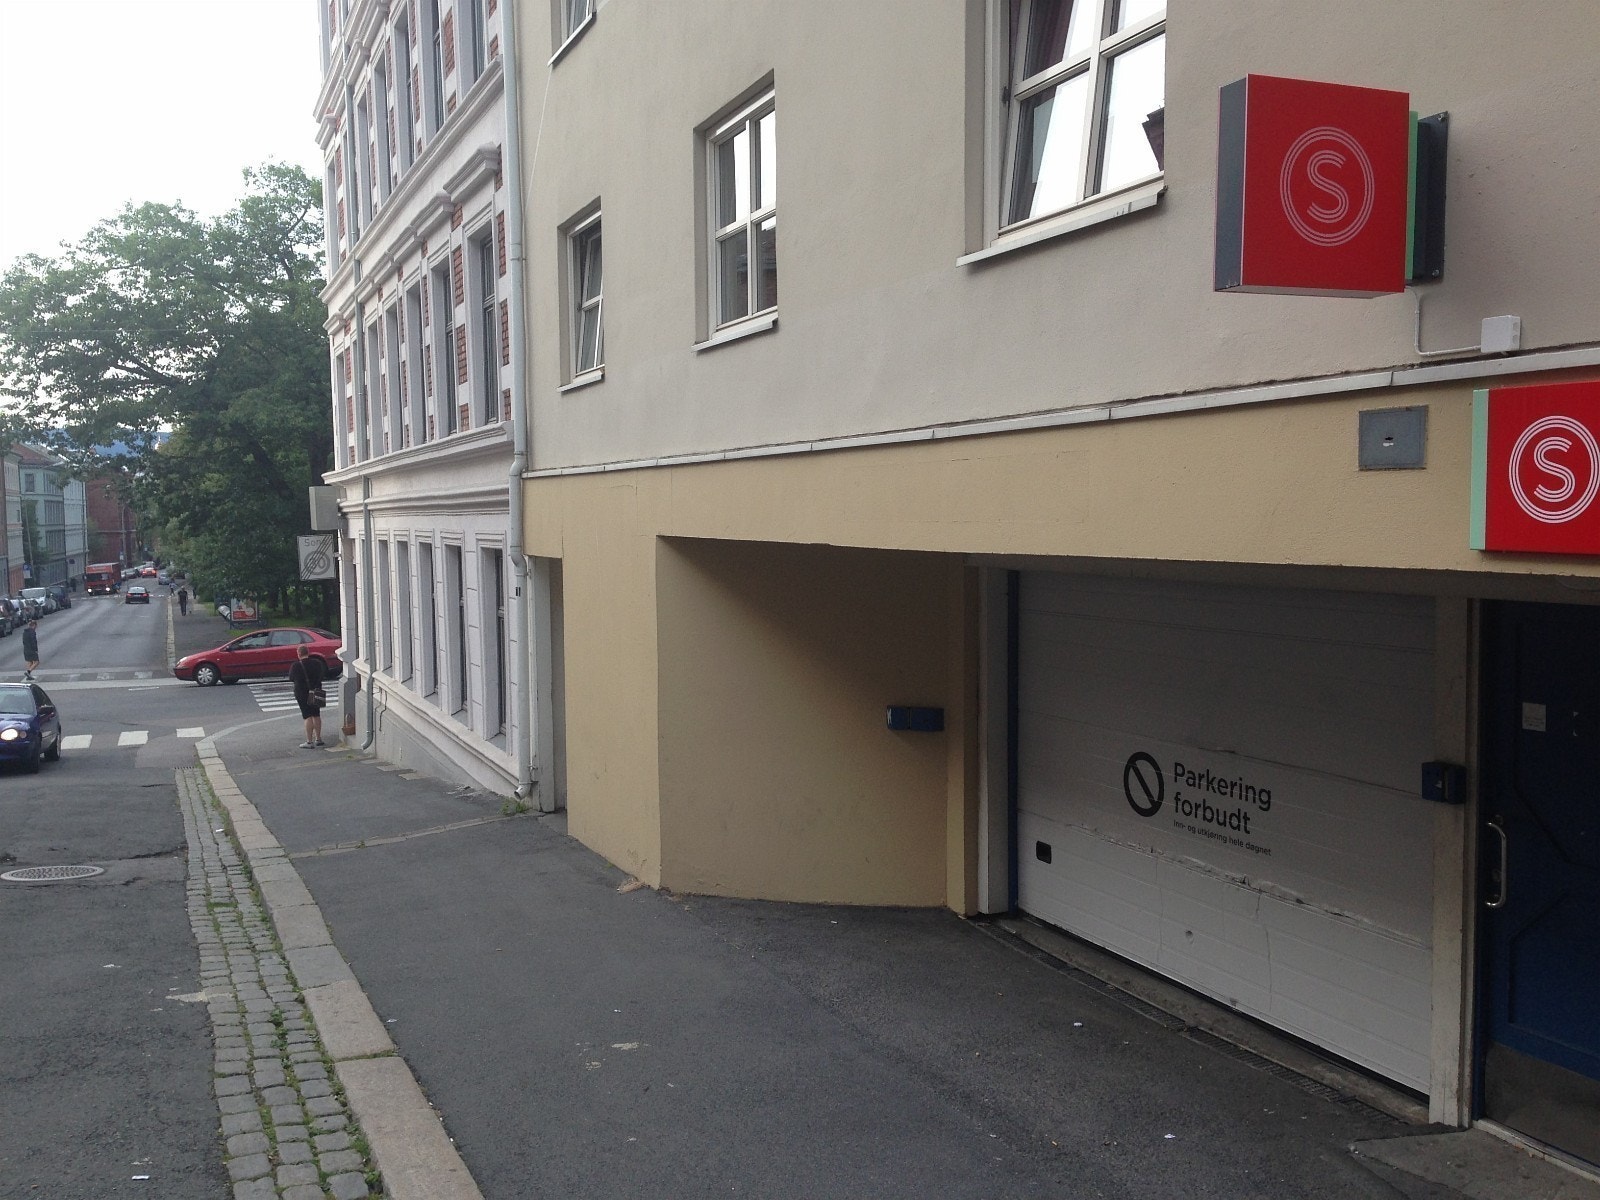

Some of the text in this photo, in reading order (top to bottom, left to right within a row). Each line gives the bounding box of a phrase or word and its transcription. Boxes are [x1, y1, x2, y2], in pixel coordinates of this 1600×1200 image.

[1306, 149, 1350, 224] S
[1533, 436, 1576, 503] S
[1174, 762, 1272, 812] Parkering
[1174, 792, 1251, 835] forbudt
[1187, 825, 1196, 835] og
[1229, 836, 1244, 848] hele
